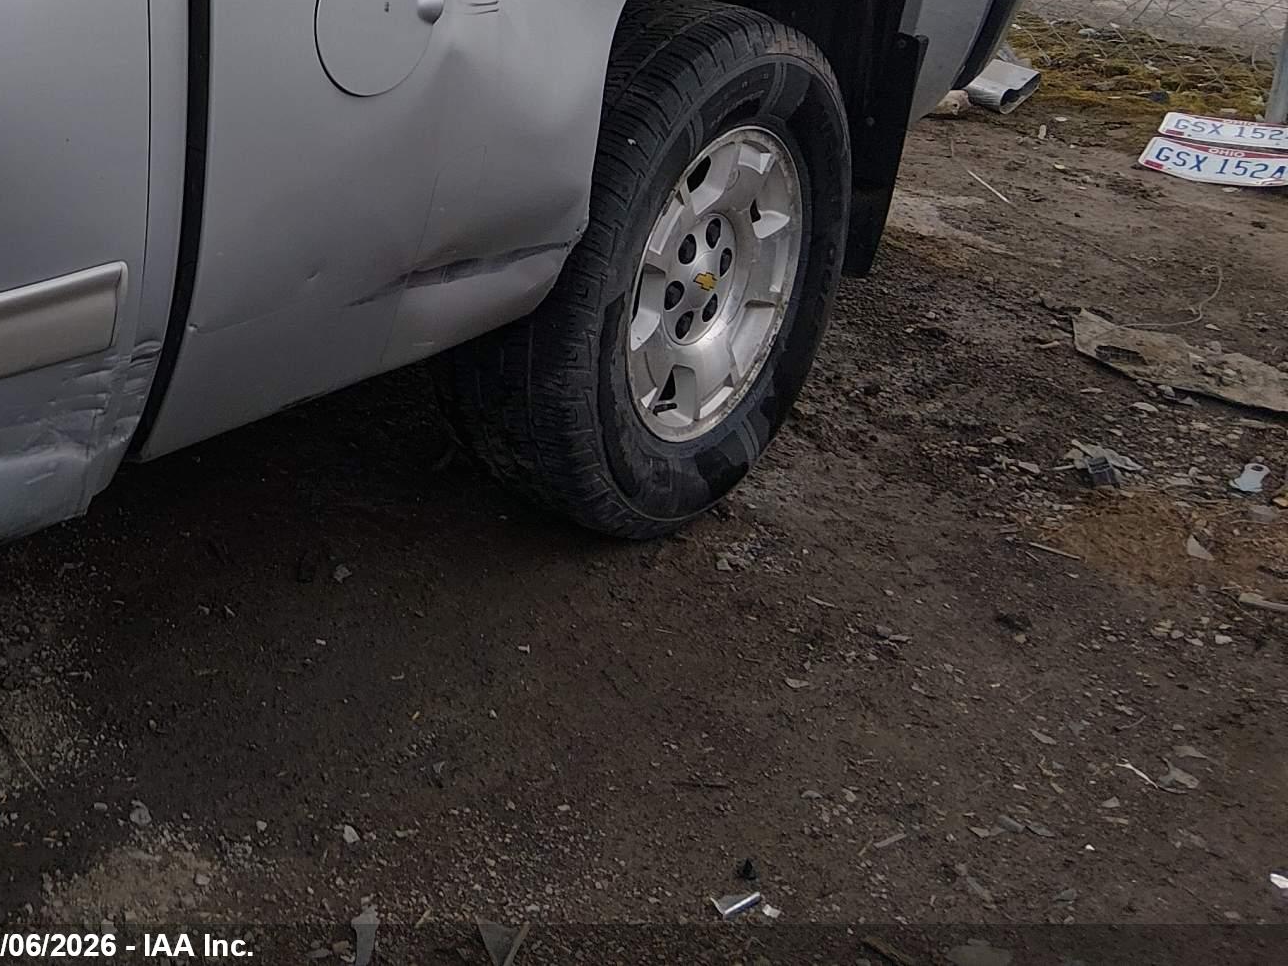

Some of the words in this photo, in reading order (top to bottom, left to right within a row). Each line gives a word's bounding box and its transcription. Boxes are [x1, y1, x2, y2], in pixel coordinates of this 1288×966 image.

[1174, 118, 1223, 136] GSX
[1233, 126, 1288, 141] 152
[1155, 146, 1209, 172] GSX
[1215, 158, 1287, 180] 152A
[1208, 147, 1246, 158] OHIO
